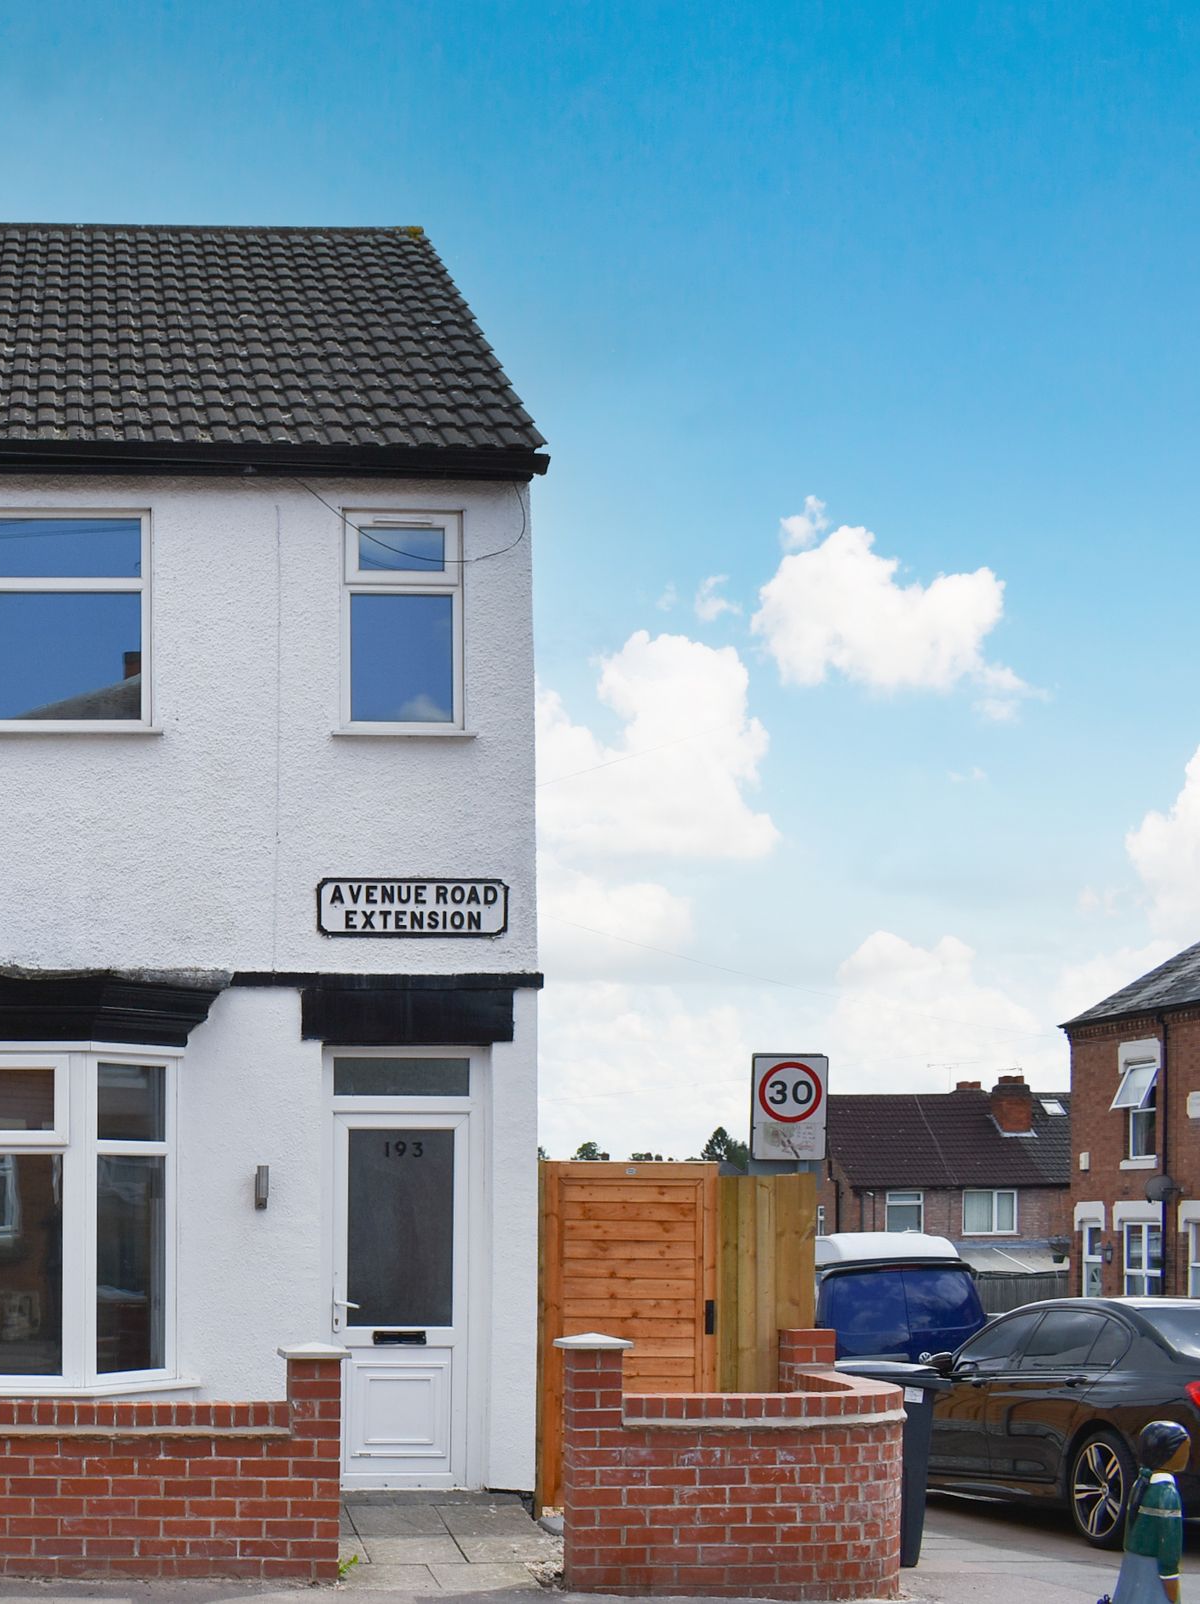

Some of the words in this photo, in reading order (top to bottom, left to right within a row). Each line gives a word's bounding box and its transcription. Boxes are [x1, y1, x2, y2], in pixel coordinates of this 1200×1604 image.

[330, 885, 427, 905] AVENUE
[436, 885, 498, 905] ROAD
[345, 910, 482, 930] EXTENSION
[769, 1080, 813, 1105] 30
[384, 1141, 424, 1158] 193
